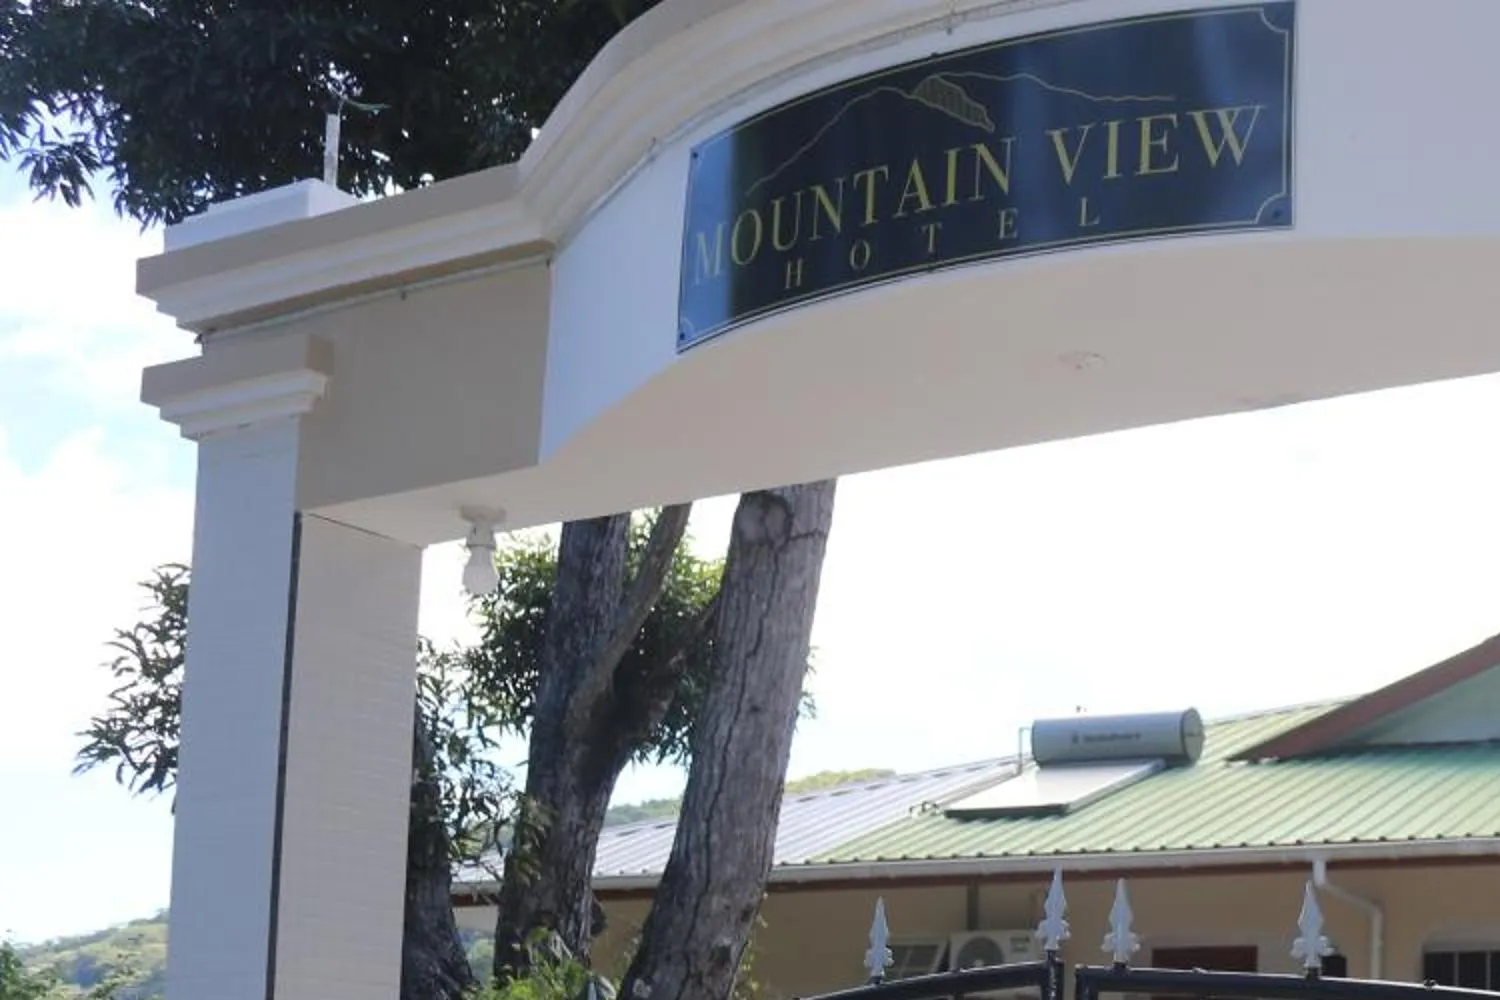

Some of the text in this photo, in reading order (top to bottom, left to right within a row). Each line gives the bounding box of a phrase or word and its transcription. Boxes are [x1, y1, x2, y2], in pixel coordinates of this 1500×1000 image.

[695, 105, 1267, 286] MOUNTAIN VIEW
[784, 197, 1100, 289] HOTEL
